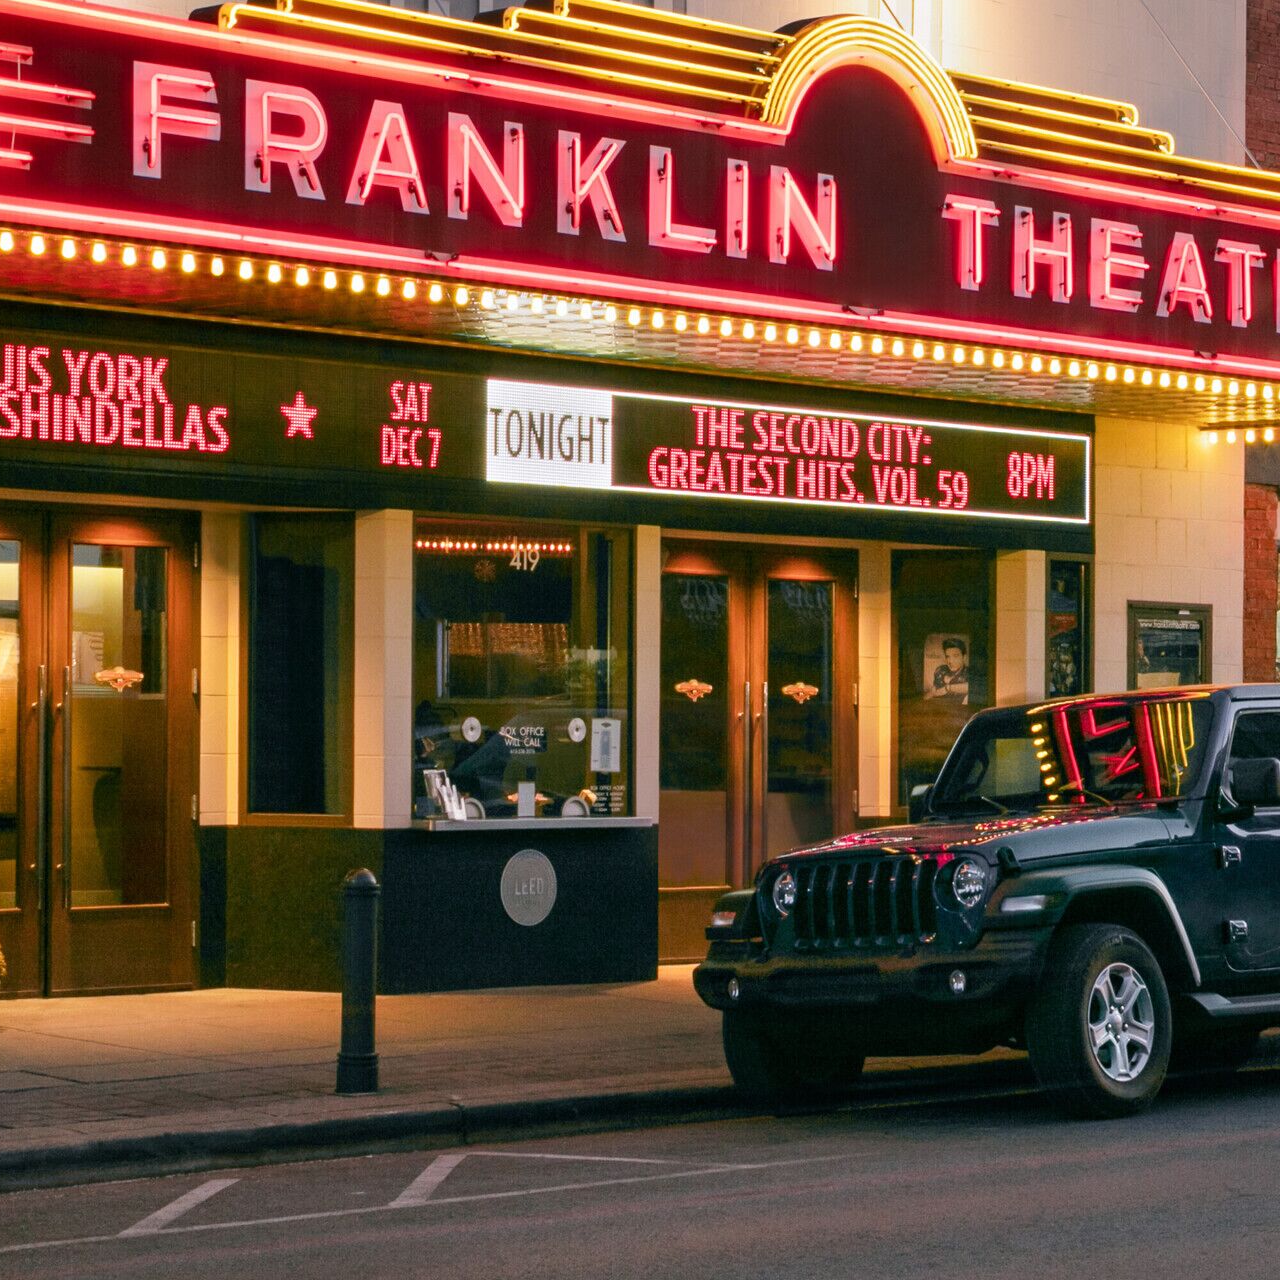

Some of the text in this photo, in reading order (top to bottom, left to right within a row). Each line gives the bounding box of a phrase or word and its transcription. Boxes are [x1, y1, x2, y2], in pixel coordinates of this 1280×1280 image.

[132, 60, 837, 272] FRANKLIN
[62, 348, 170, 405] YORK
[390, 380, 433, 423] SAT
[380, 425, 443, 469] DEC 7
[489, 407, 610, 465] TONIGHT
[691, 404, 933, 466] THE SECOND CITY:
[647, 446, 790, 497] GREATEST
[872, 464, 933, 507] VOL.
[937, 470, 970, 510] 59
[1006, 451, 1056, 501] 8PM
[509, 549, 540, 571] 419
[520, 726, 545, 737] OFFICE
[524, 738, 541, 747] CALL
